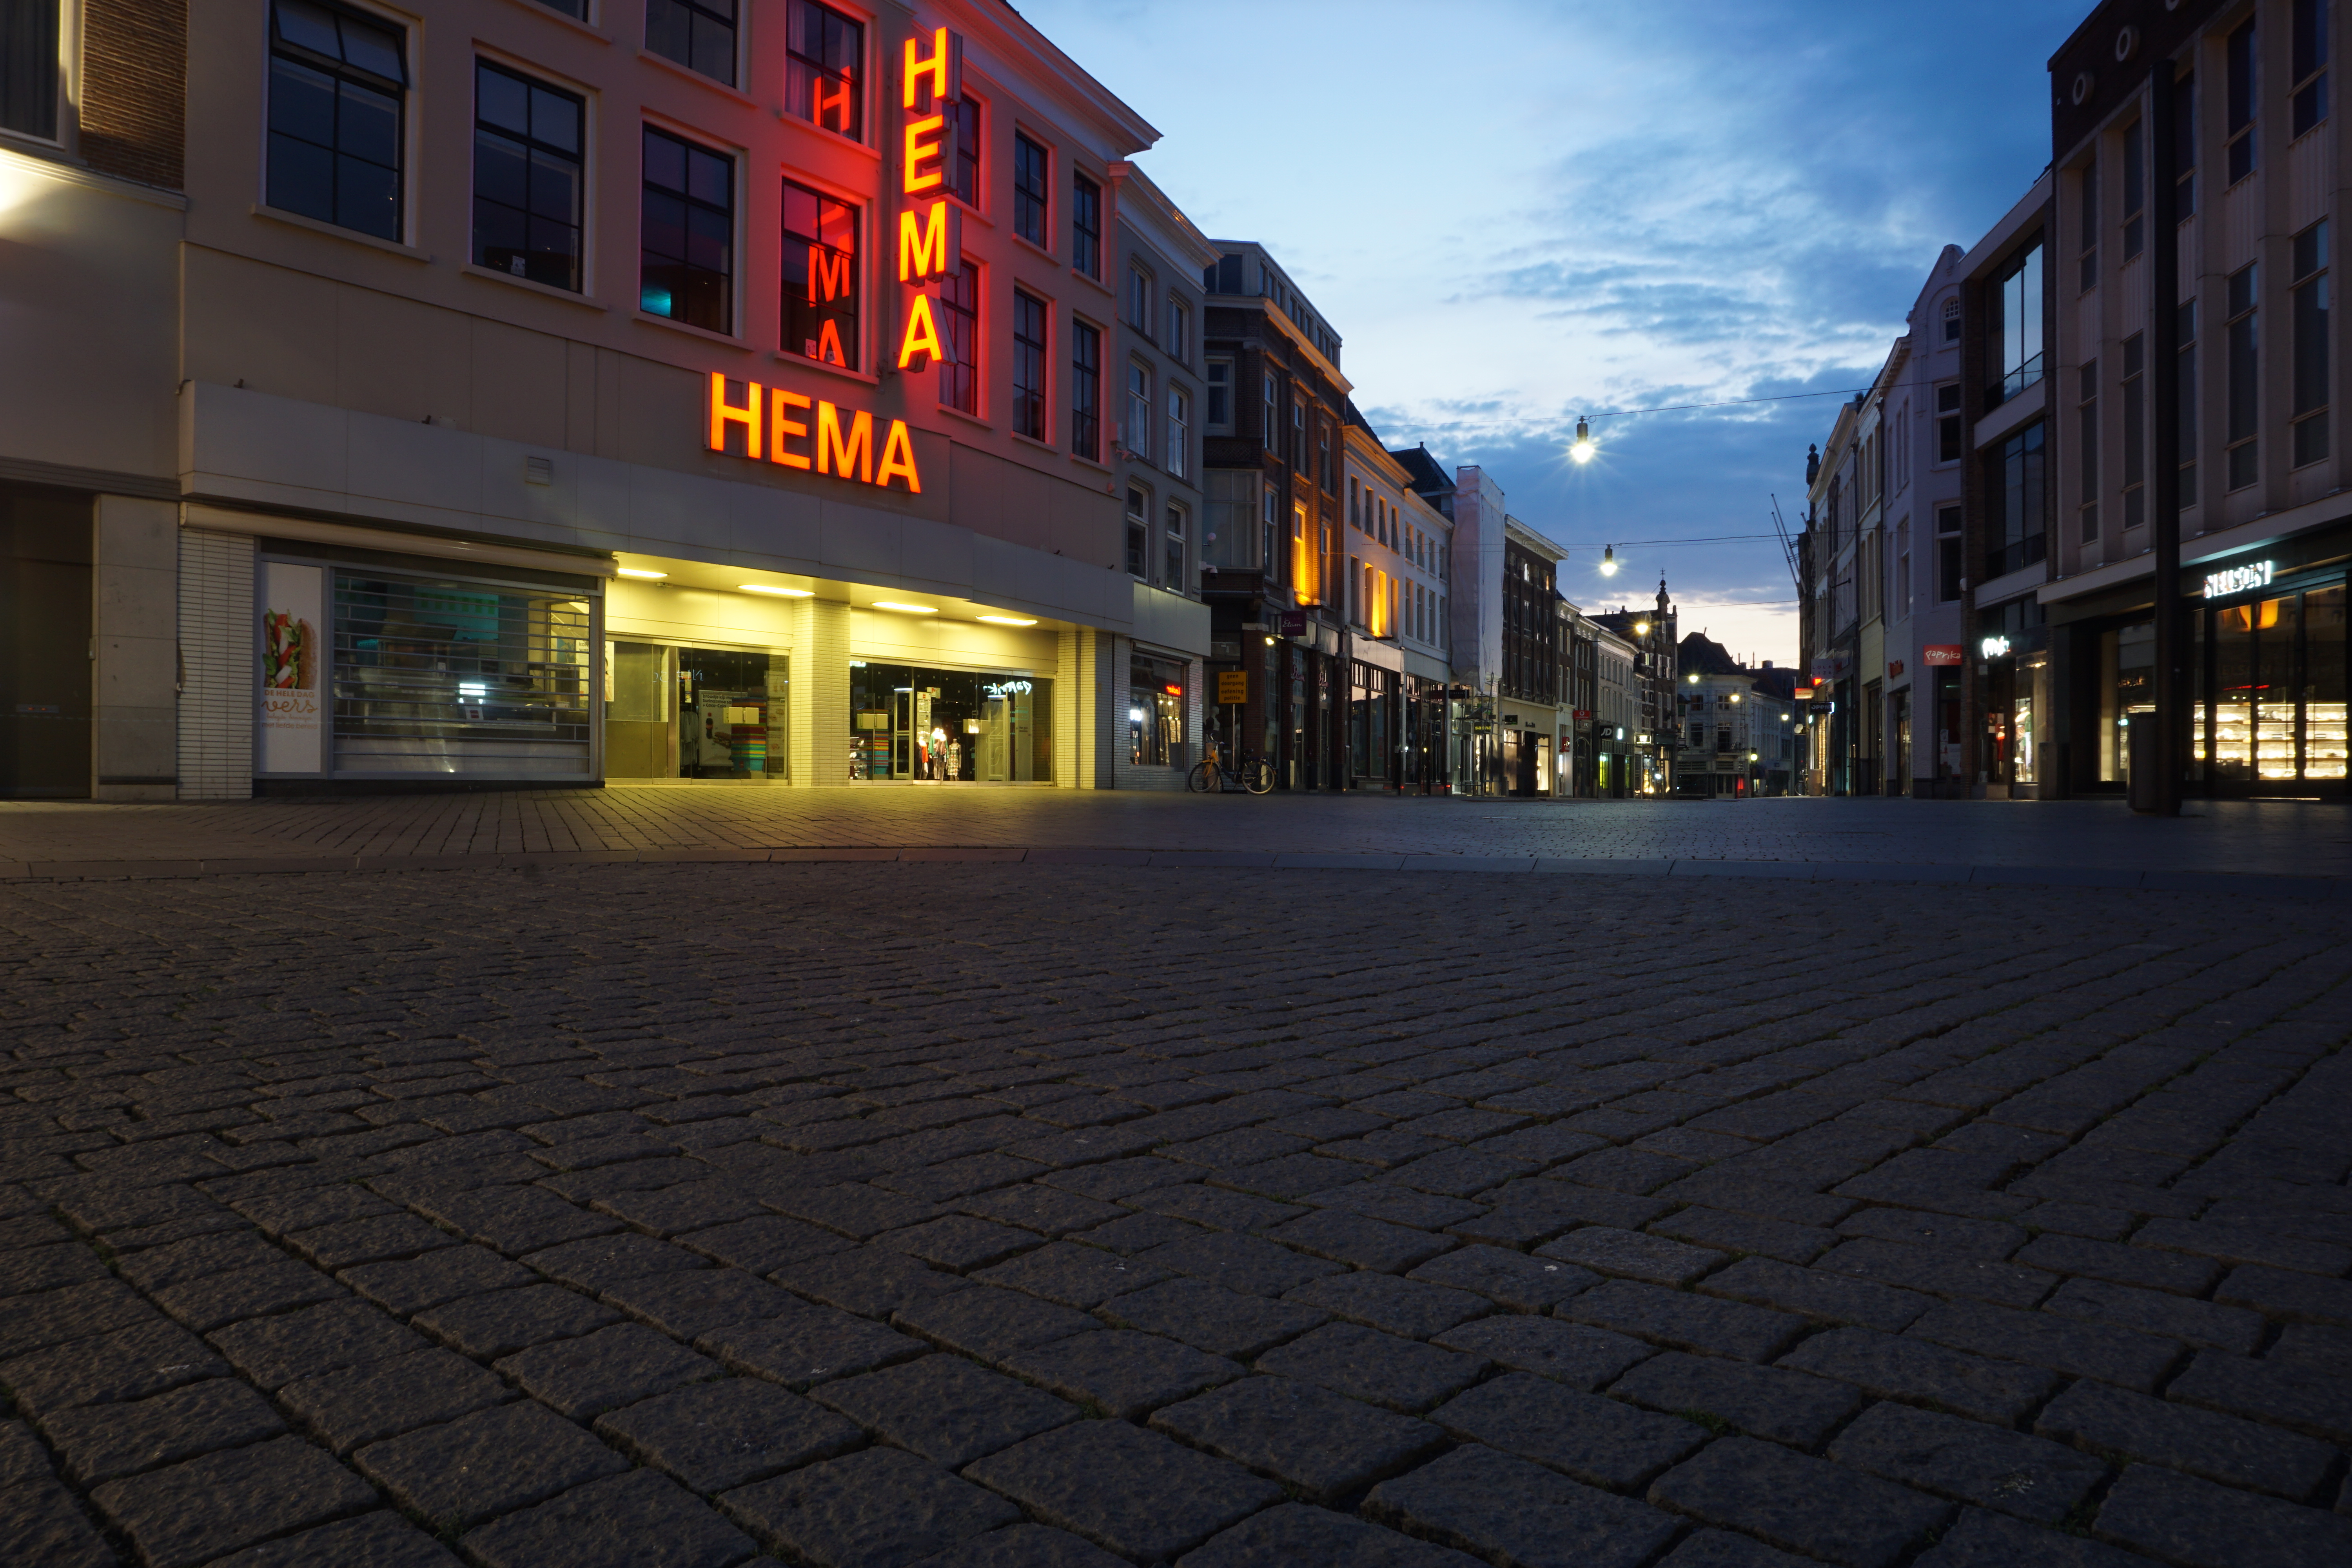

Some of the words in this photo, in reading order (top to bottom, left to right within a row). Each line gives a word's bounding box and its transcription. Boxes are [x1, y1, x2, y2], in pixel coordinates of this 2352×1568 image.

[898, 26, 953, 369] HEMA
[710, 371, 921, 494] HEMA
[2203, 560, 2272, 598] NELSON
[1926, 650, 1960, 660] paprika
[261, 699, 318, 713] vers
[1601, 728, 1612, 736] JD
